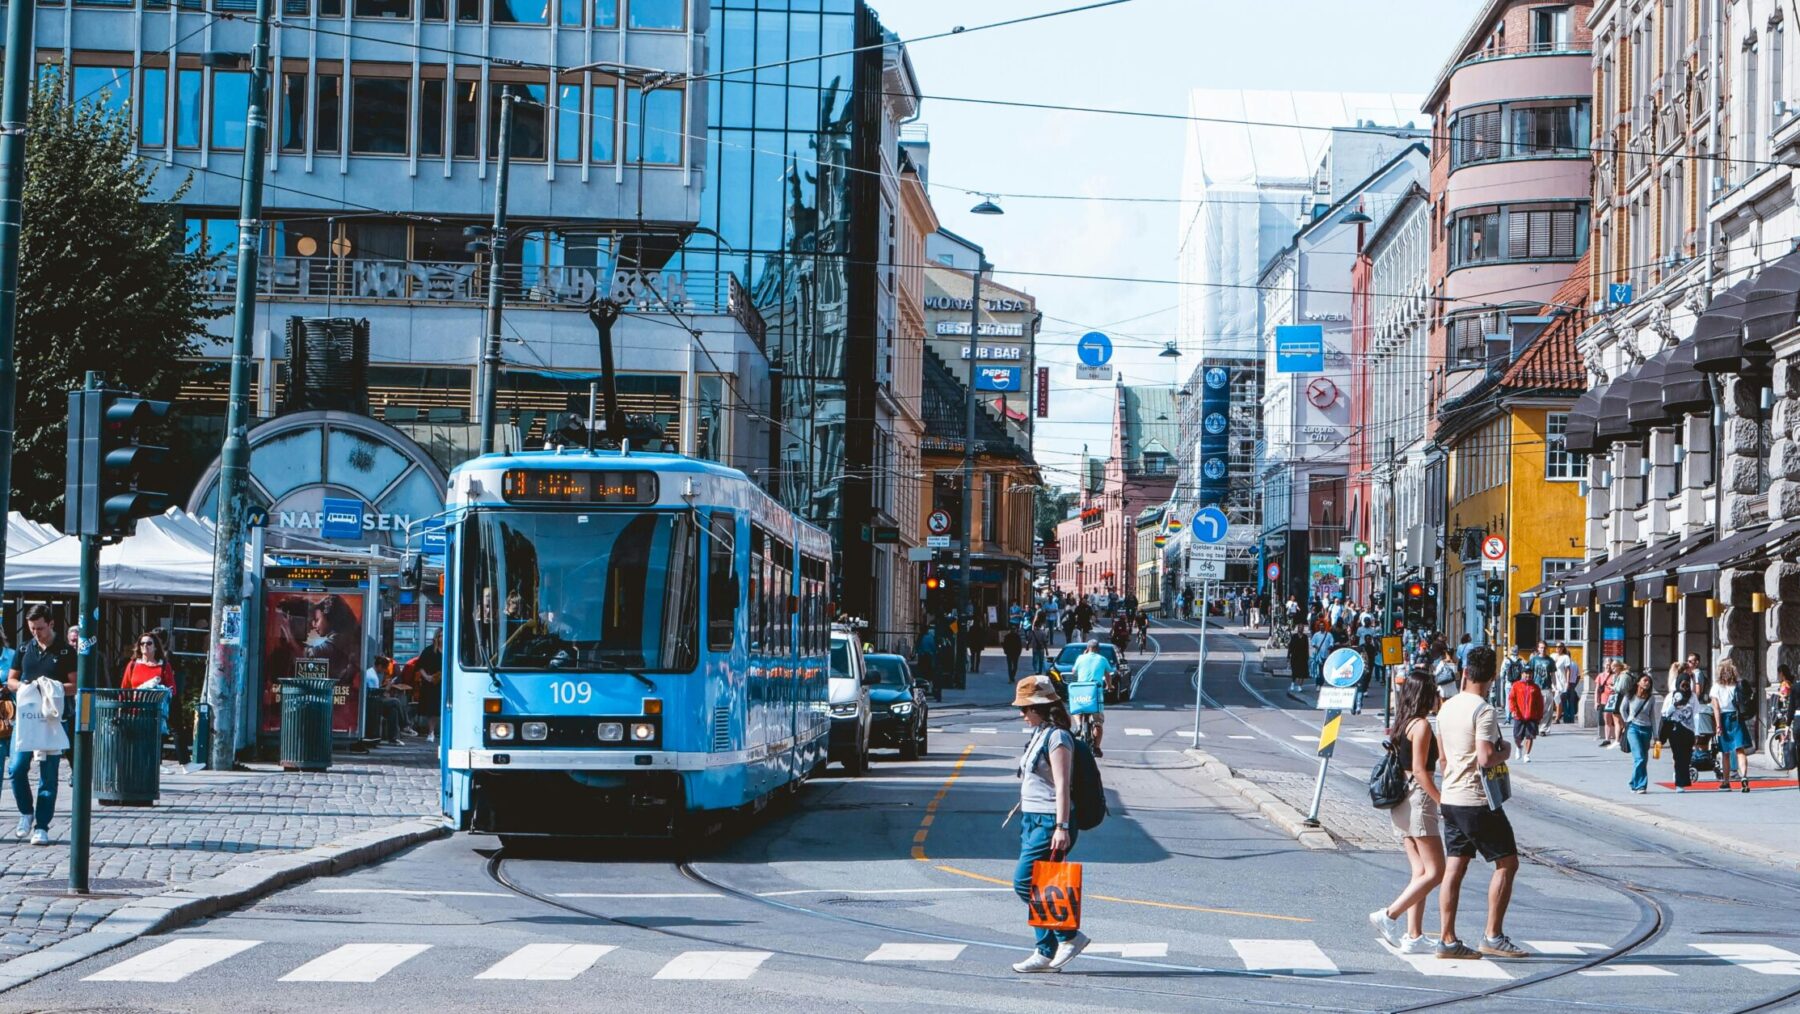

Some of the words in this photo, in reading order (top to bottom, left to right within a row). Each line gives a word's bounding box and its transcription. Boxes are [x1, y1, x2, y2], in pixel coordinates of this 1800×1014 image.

[986, 298, 1023, 312] LISA
[936, 322, 1023, 336] RESTURANT
[994, 347, 1020, 359] BAR
[982, 368, 1010, 377] PEPSI
[1311, 433, 1329, 442] City
[1192, 543, 1212, 551] Gjelder
[1428, 586, 1435, 596] S
[550, 681, 592, 704] 109
